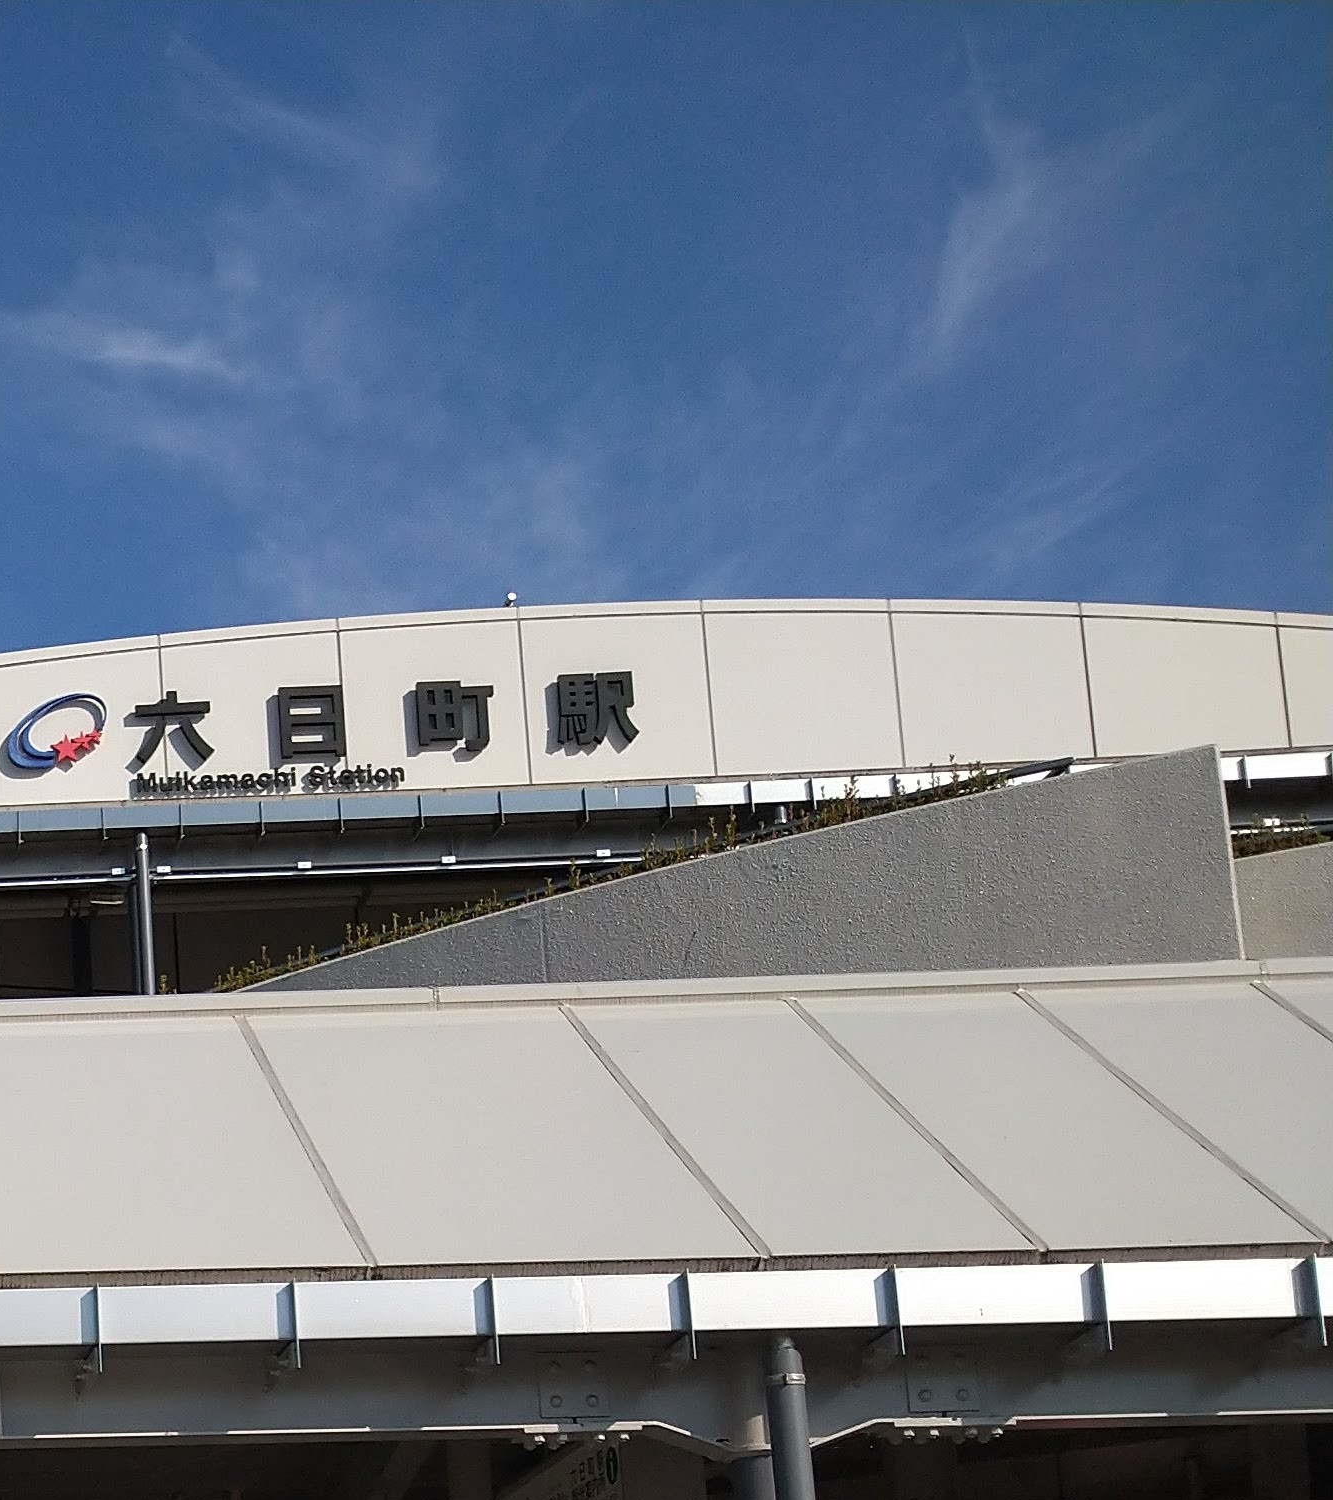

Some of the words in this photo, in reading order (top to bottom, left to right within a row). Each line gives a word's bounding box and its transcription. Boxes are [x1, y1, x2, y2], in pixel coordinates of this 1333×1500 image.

[132, 671, 640, 766] 六日町駅
[136, 766, 298, 794] Muikamachi
[308, 763, 406, 787] Station
